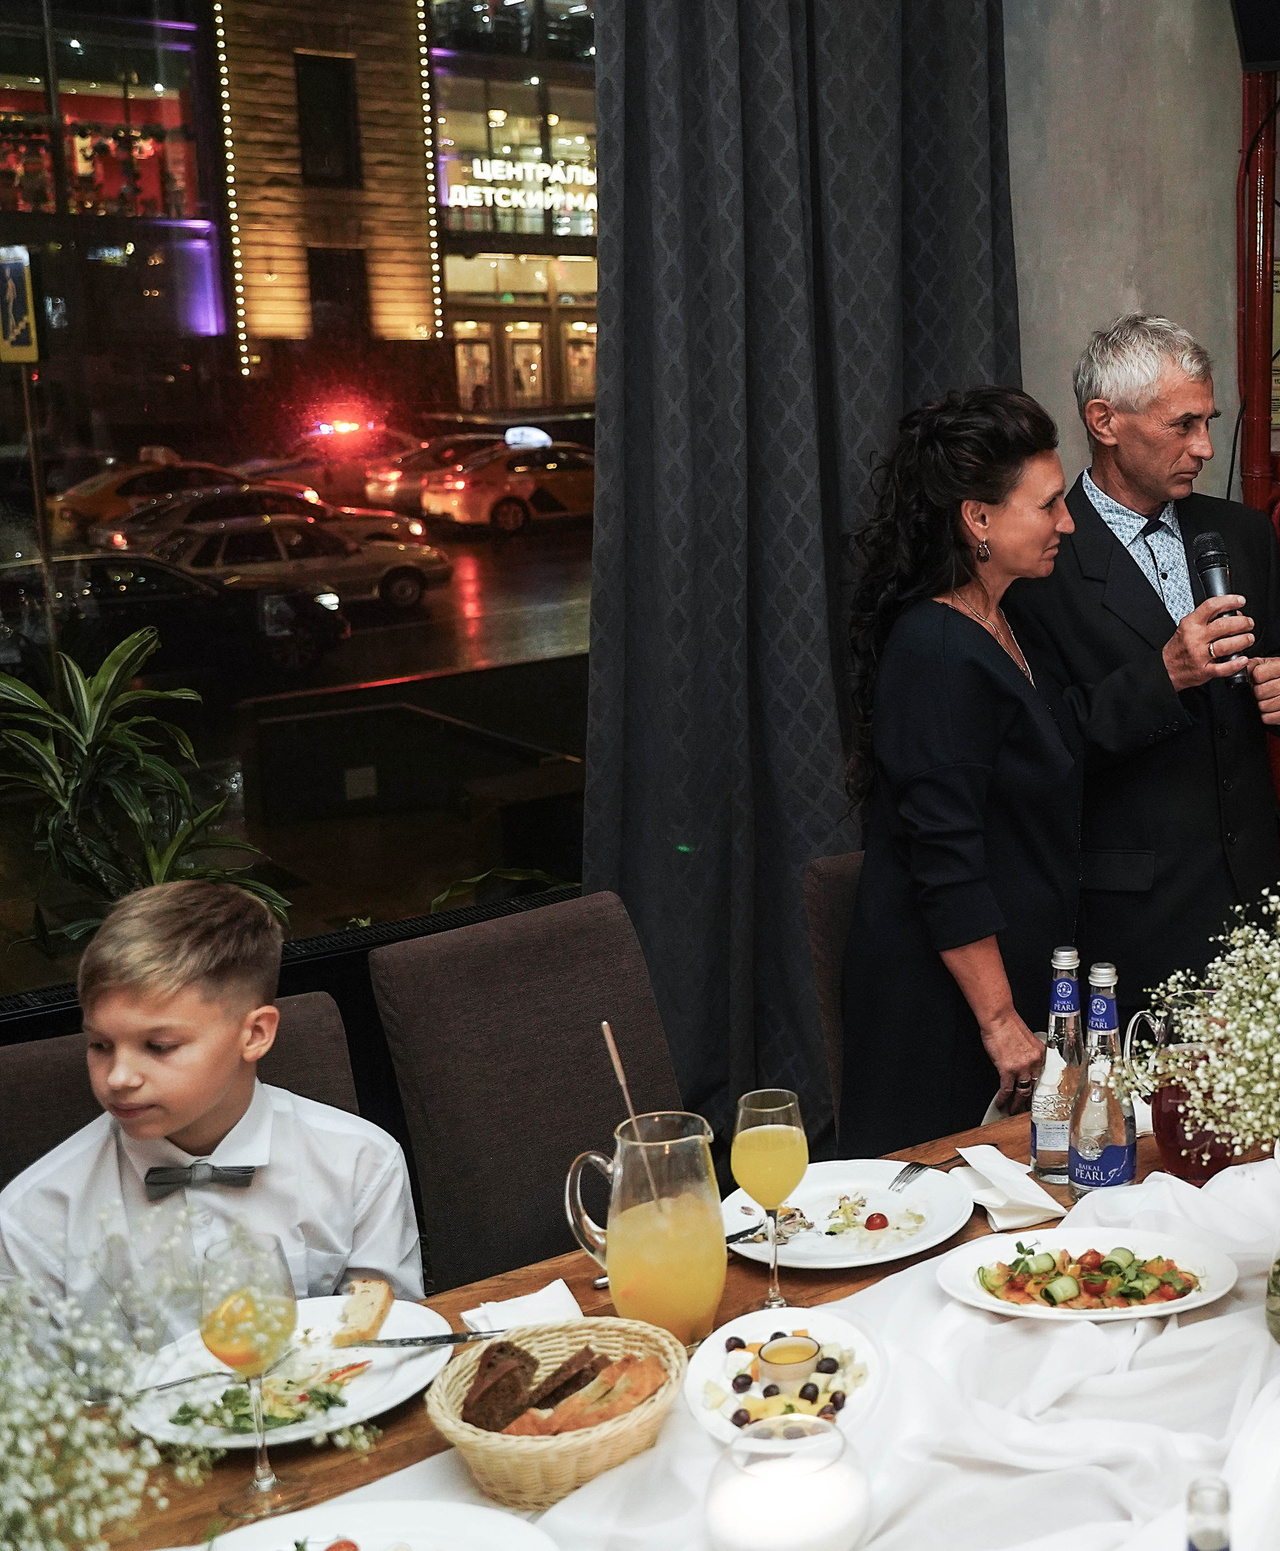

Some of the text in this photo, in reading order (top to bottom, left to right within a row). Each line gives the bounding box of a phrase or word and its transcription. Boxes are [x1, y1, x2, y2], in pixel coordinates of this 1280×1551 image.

[472, 158, 598, 186] ЦЕНТРАЛЬ
[449, 184, 565, 210] ДЕТСКИЙ
[1053, 1003, 1075, 1011] PEARL
[1088, 1020, 1109, 1029] PEARL
[1078, 1162, 1101, 1171] BAIKAL
[1075, 1167, 1107, 1181] PEARL
